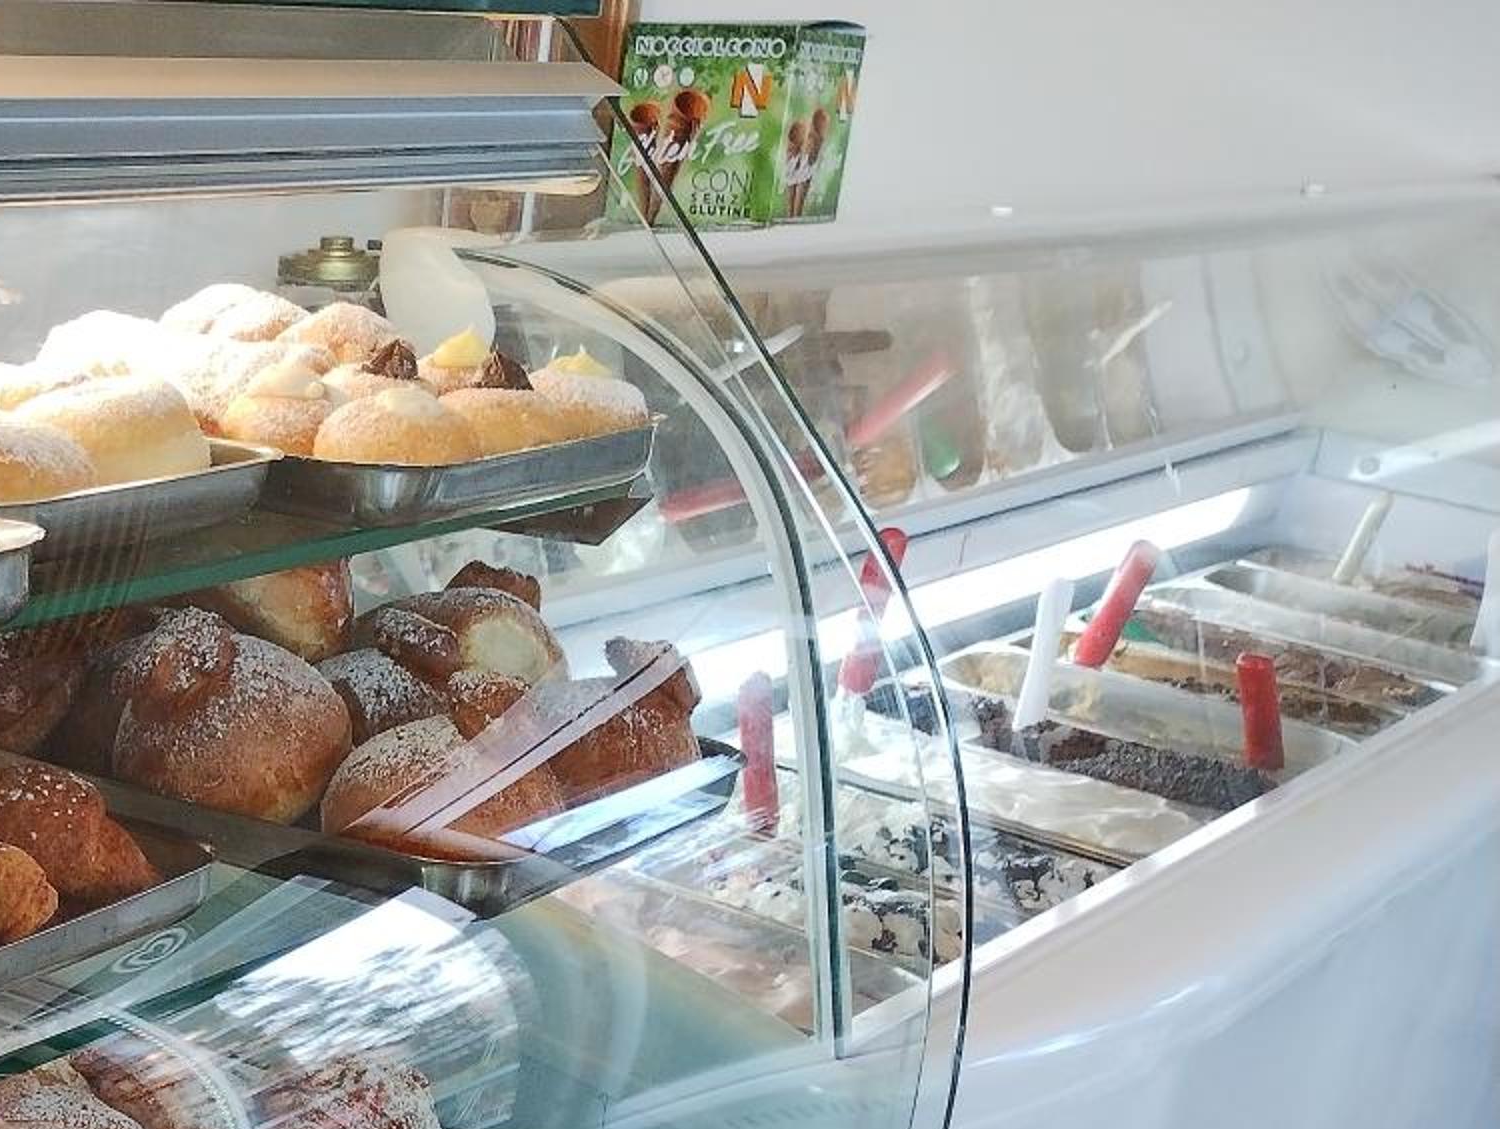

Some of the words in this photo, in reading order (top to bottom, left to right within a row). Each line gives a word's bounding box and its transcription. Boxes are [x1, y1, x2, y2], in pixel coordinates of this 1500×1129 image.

[635, 35, 787, 59] NOCCIOLCONO
[730, 62, 774, 119] N
[691, 168, 756, 194] CONI
[689, 204, 752, 218] GLUTINE
